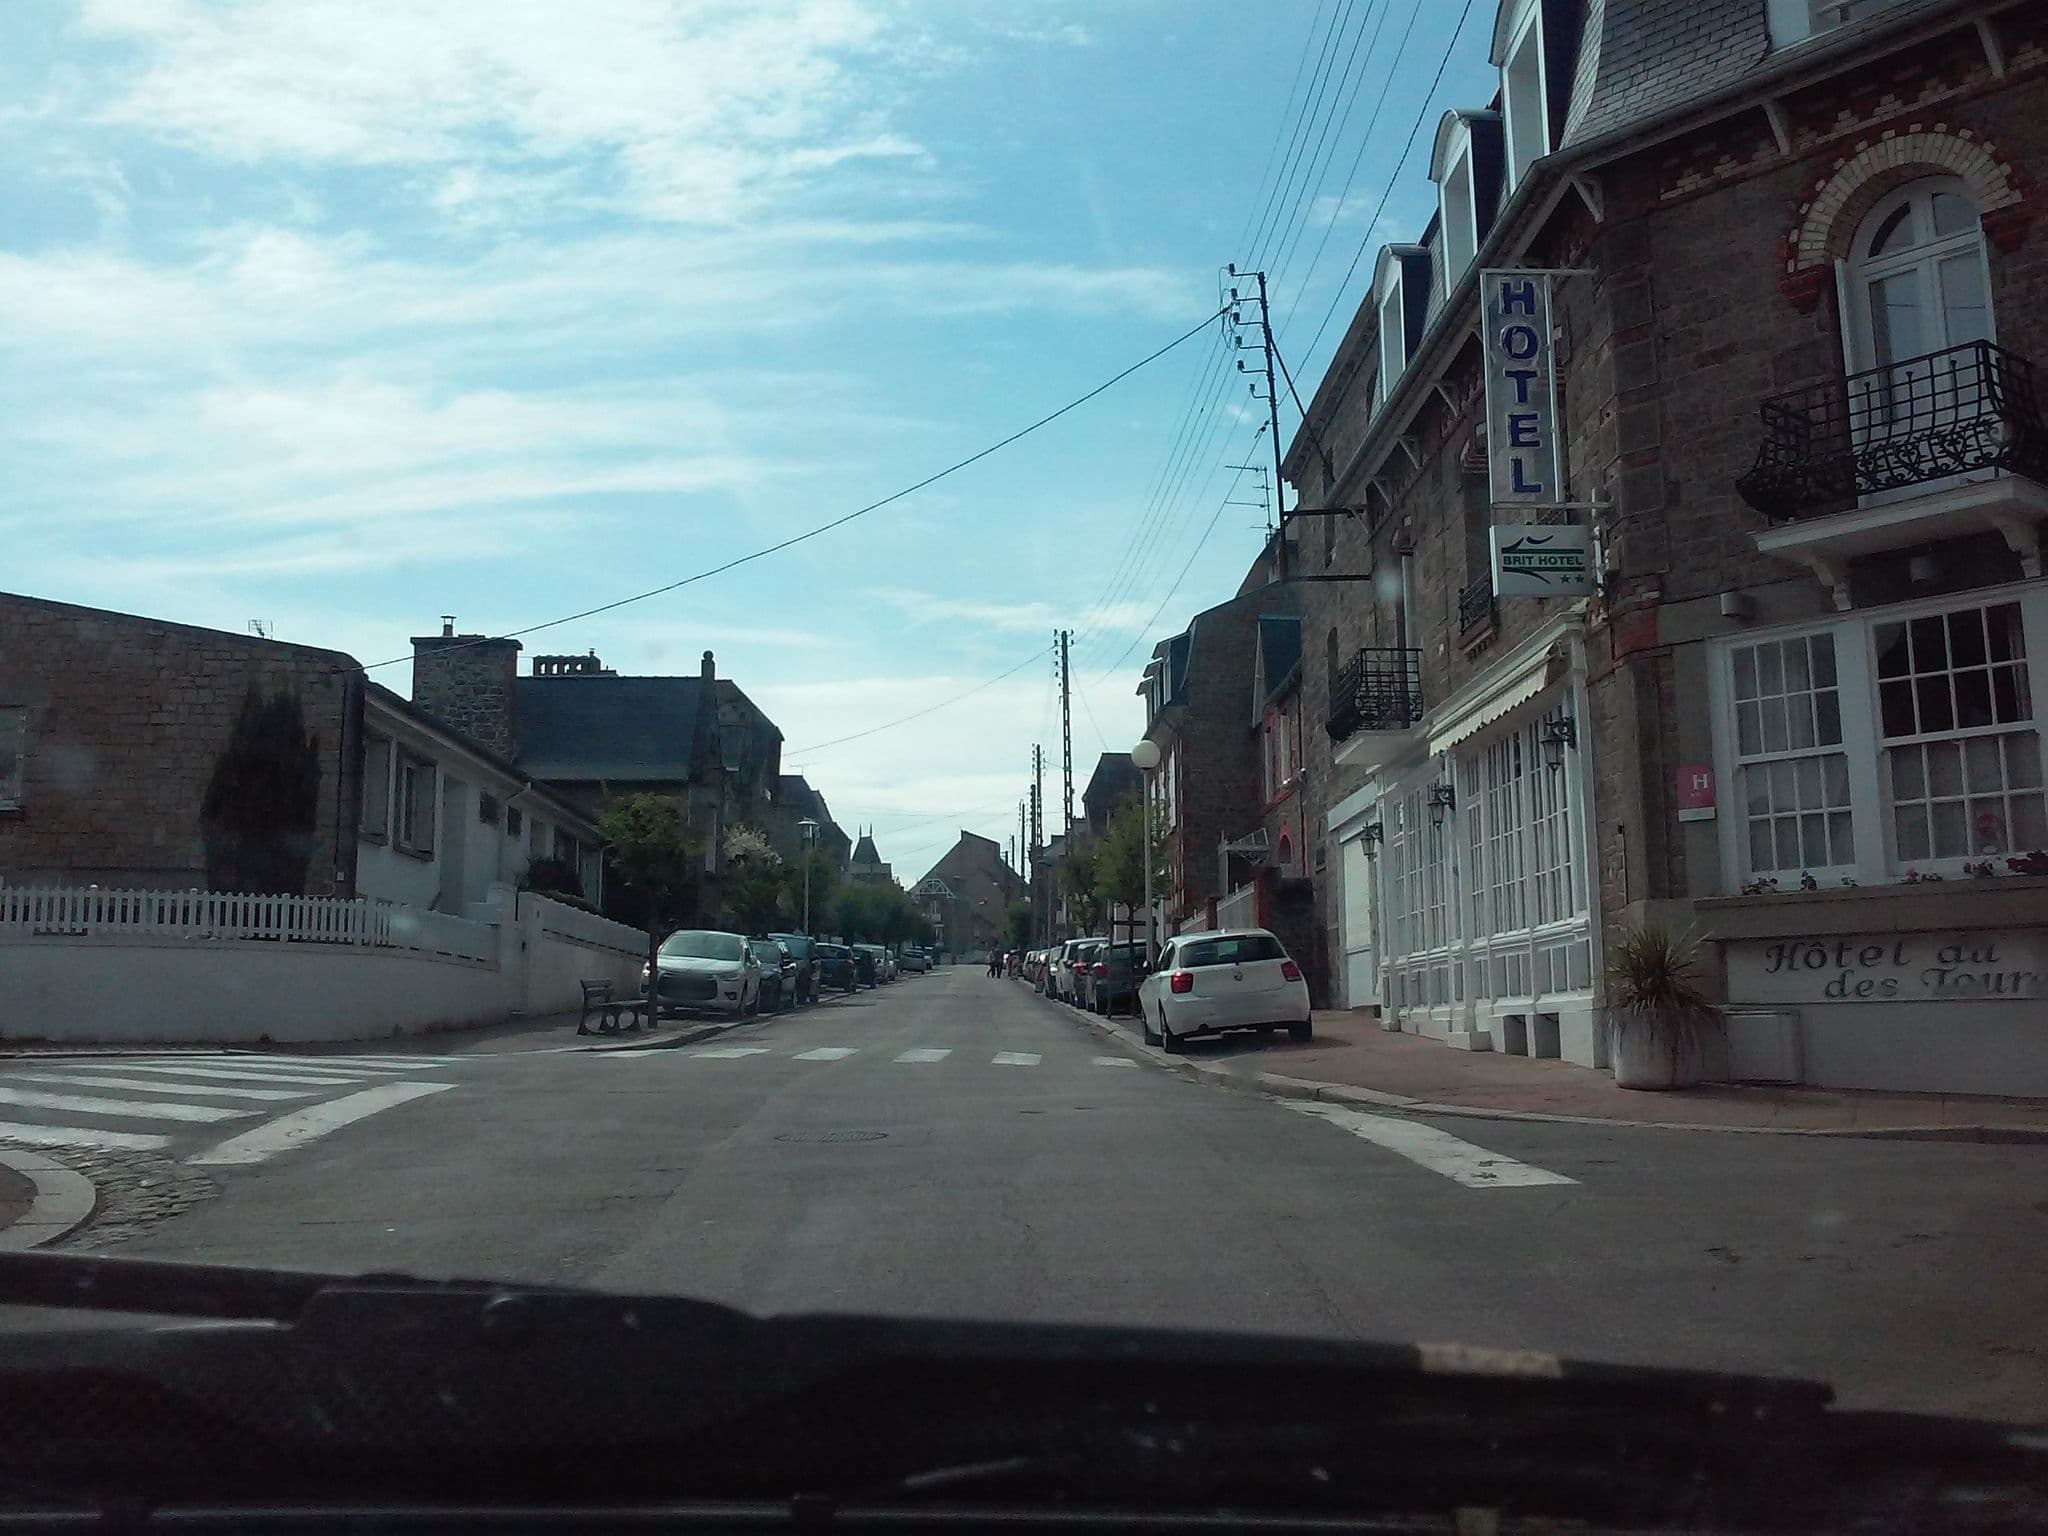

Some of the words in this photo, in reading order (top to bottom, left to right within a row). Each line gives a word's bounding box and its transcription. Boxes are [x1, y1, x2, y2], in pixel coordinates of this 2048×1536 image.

[1502, 280, 1542, 494] HOTEL
[1502, 555, 1535, 566] BRIT
[1538, 555, 1583, 566] HOTEL
[1692, 773, 1709, 790] H
[1765, 941, 1912, 974] Hôtel
[1936, 943, 2001, 965] au
[1824, 969, 1898, 999] des
